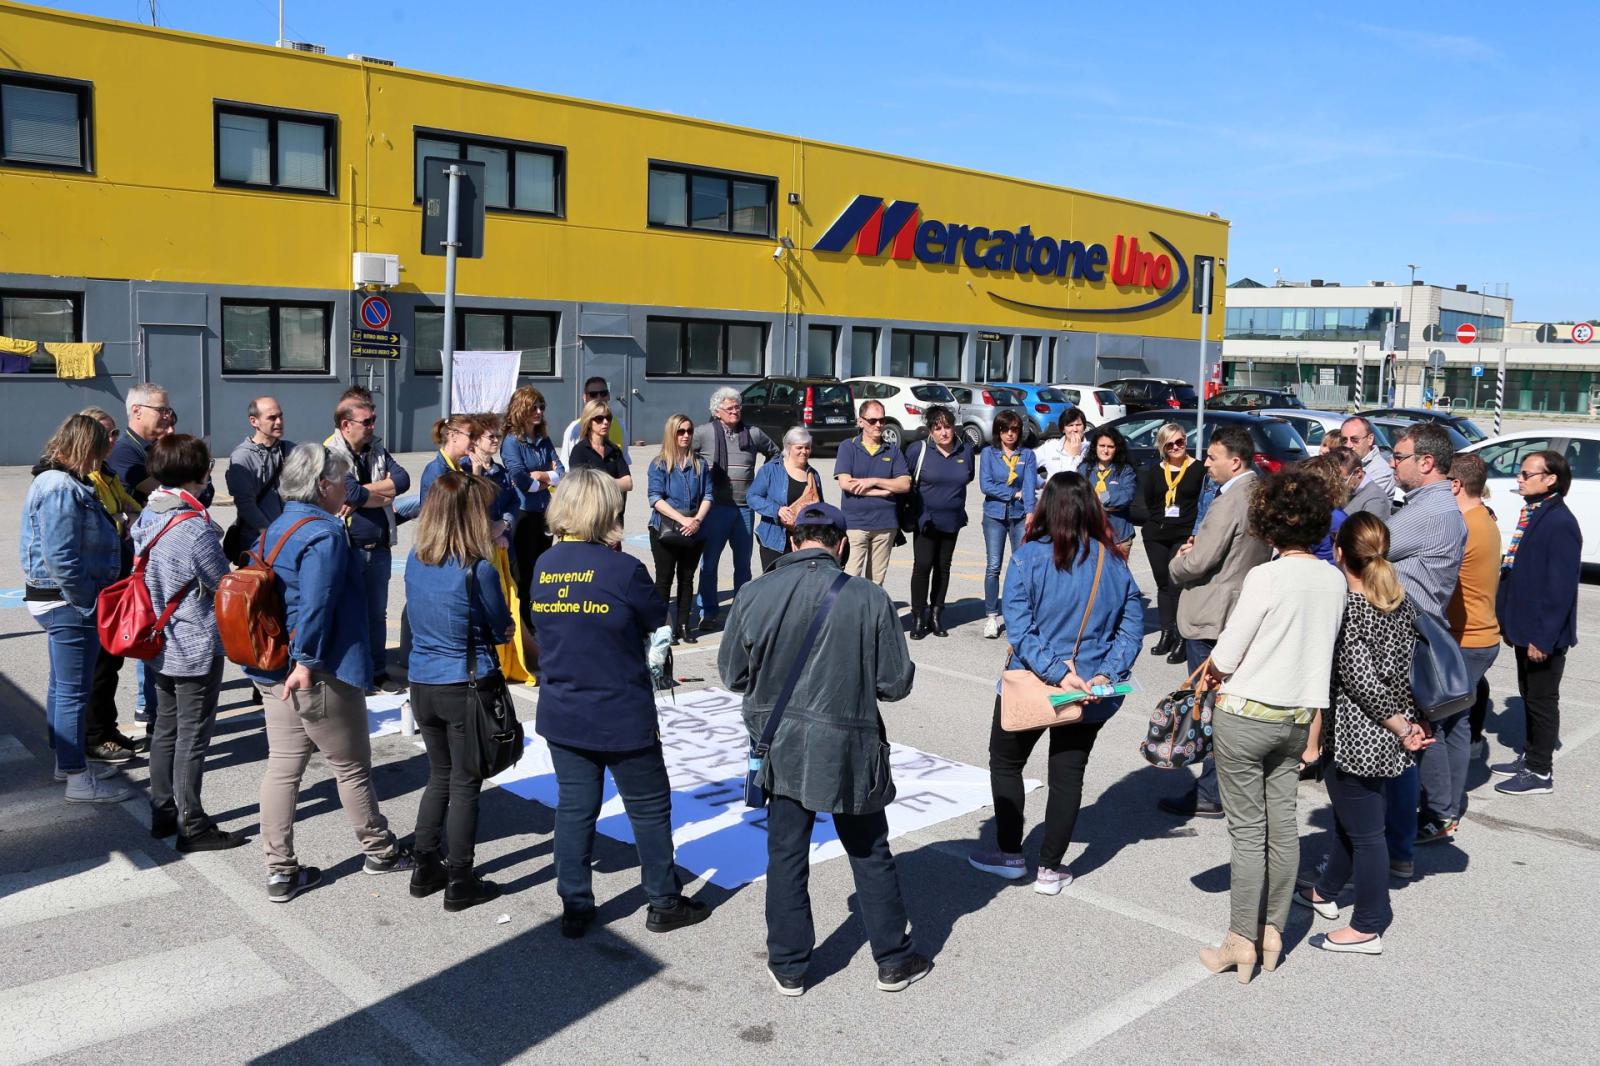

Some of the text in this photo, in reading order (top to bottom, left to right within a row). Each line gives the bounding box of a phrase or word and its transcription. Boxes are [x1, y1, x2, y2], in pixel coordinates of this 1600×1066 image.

[811, 194, 1172, 290] Mercatone Uno
[540, 570, 594, 584] Benvenuti
[558, 585, 569, 598] al
[583, 600, 609, 613] Uno
